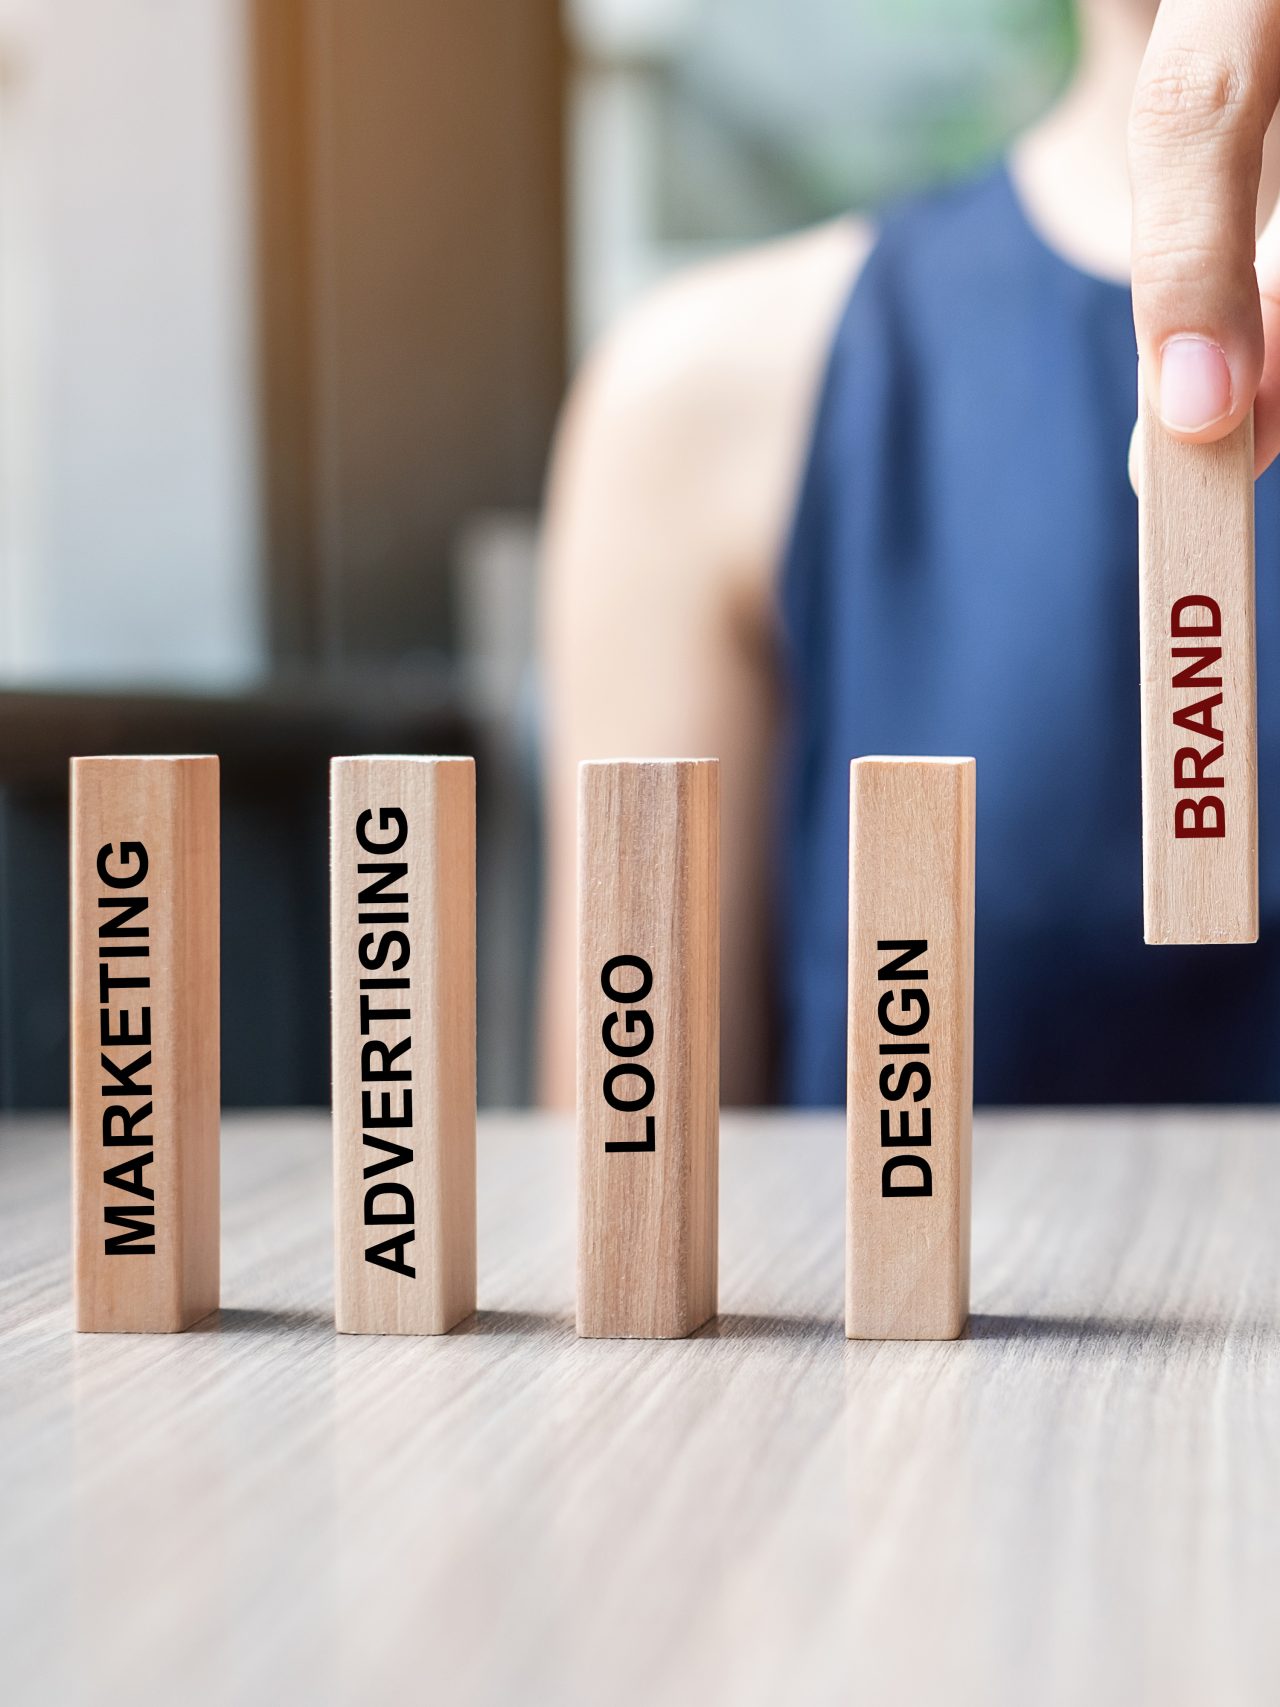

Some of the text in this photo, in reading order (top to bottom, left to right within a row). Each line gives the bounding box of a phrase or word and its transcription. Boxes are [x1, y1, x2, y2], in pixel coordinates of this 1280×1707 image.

[1170, 594, 1226, 839] BRAND
[96, 841, 156, 1256] MARKETING
[355, 807, 416, 1279] ADVERTISING
[600, 954, 656, 1153] LOGO
[877, 939, 933, 1198] DESIGN
